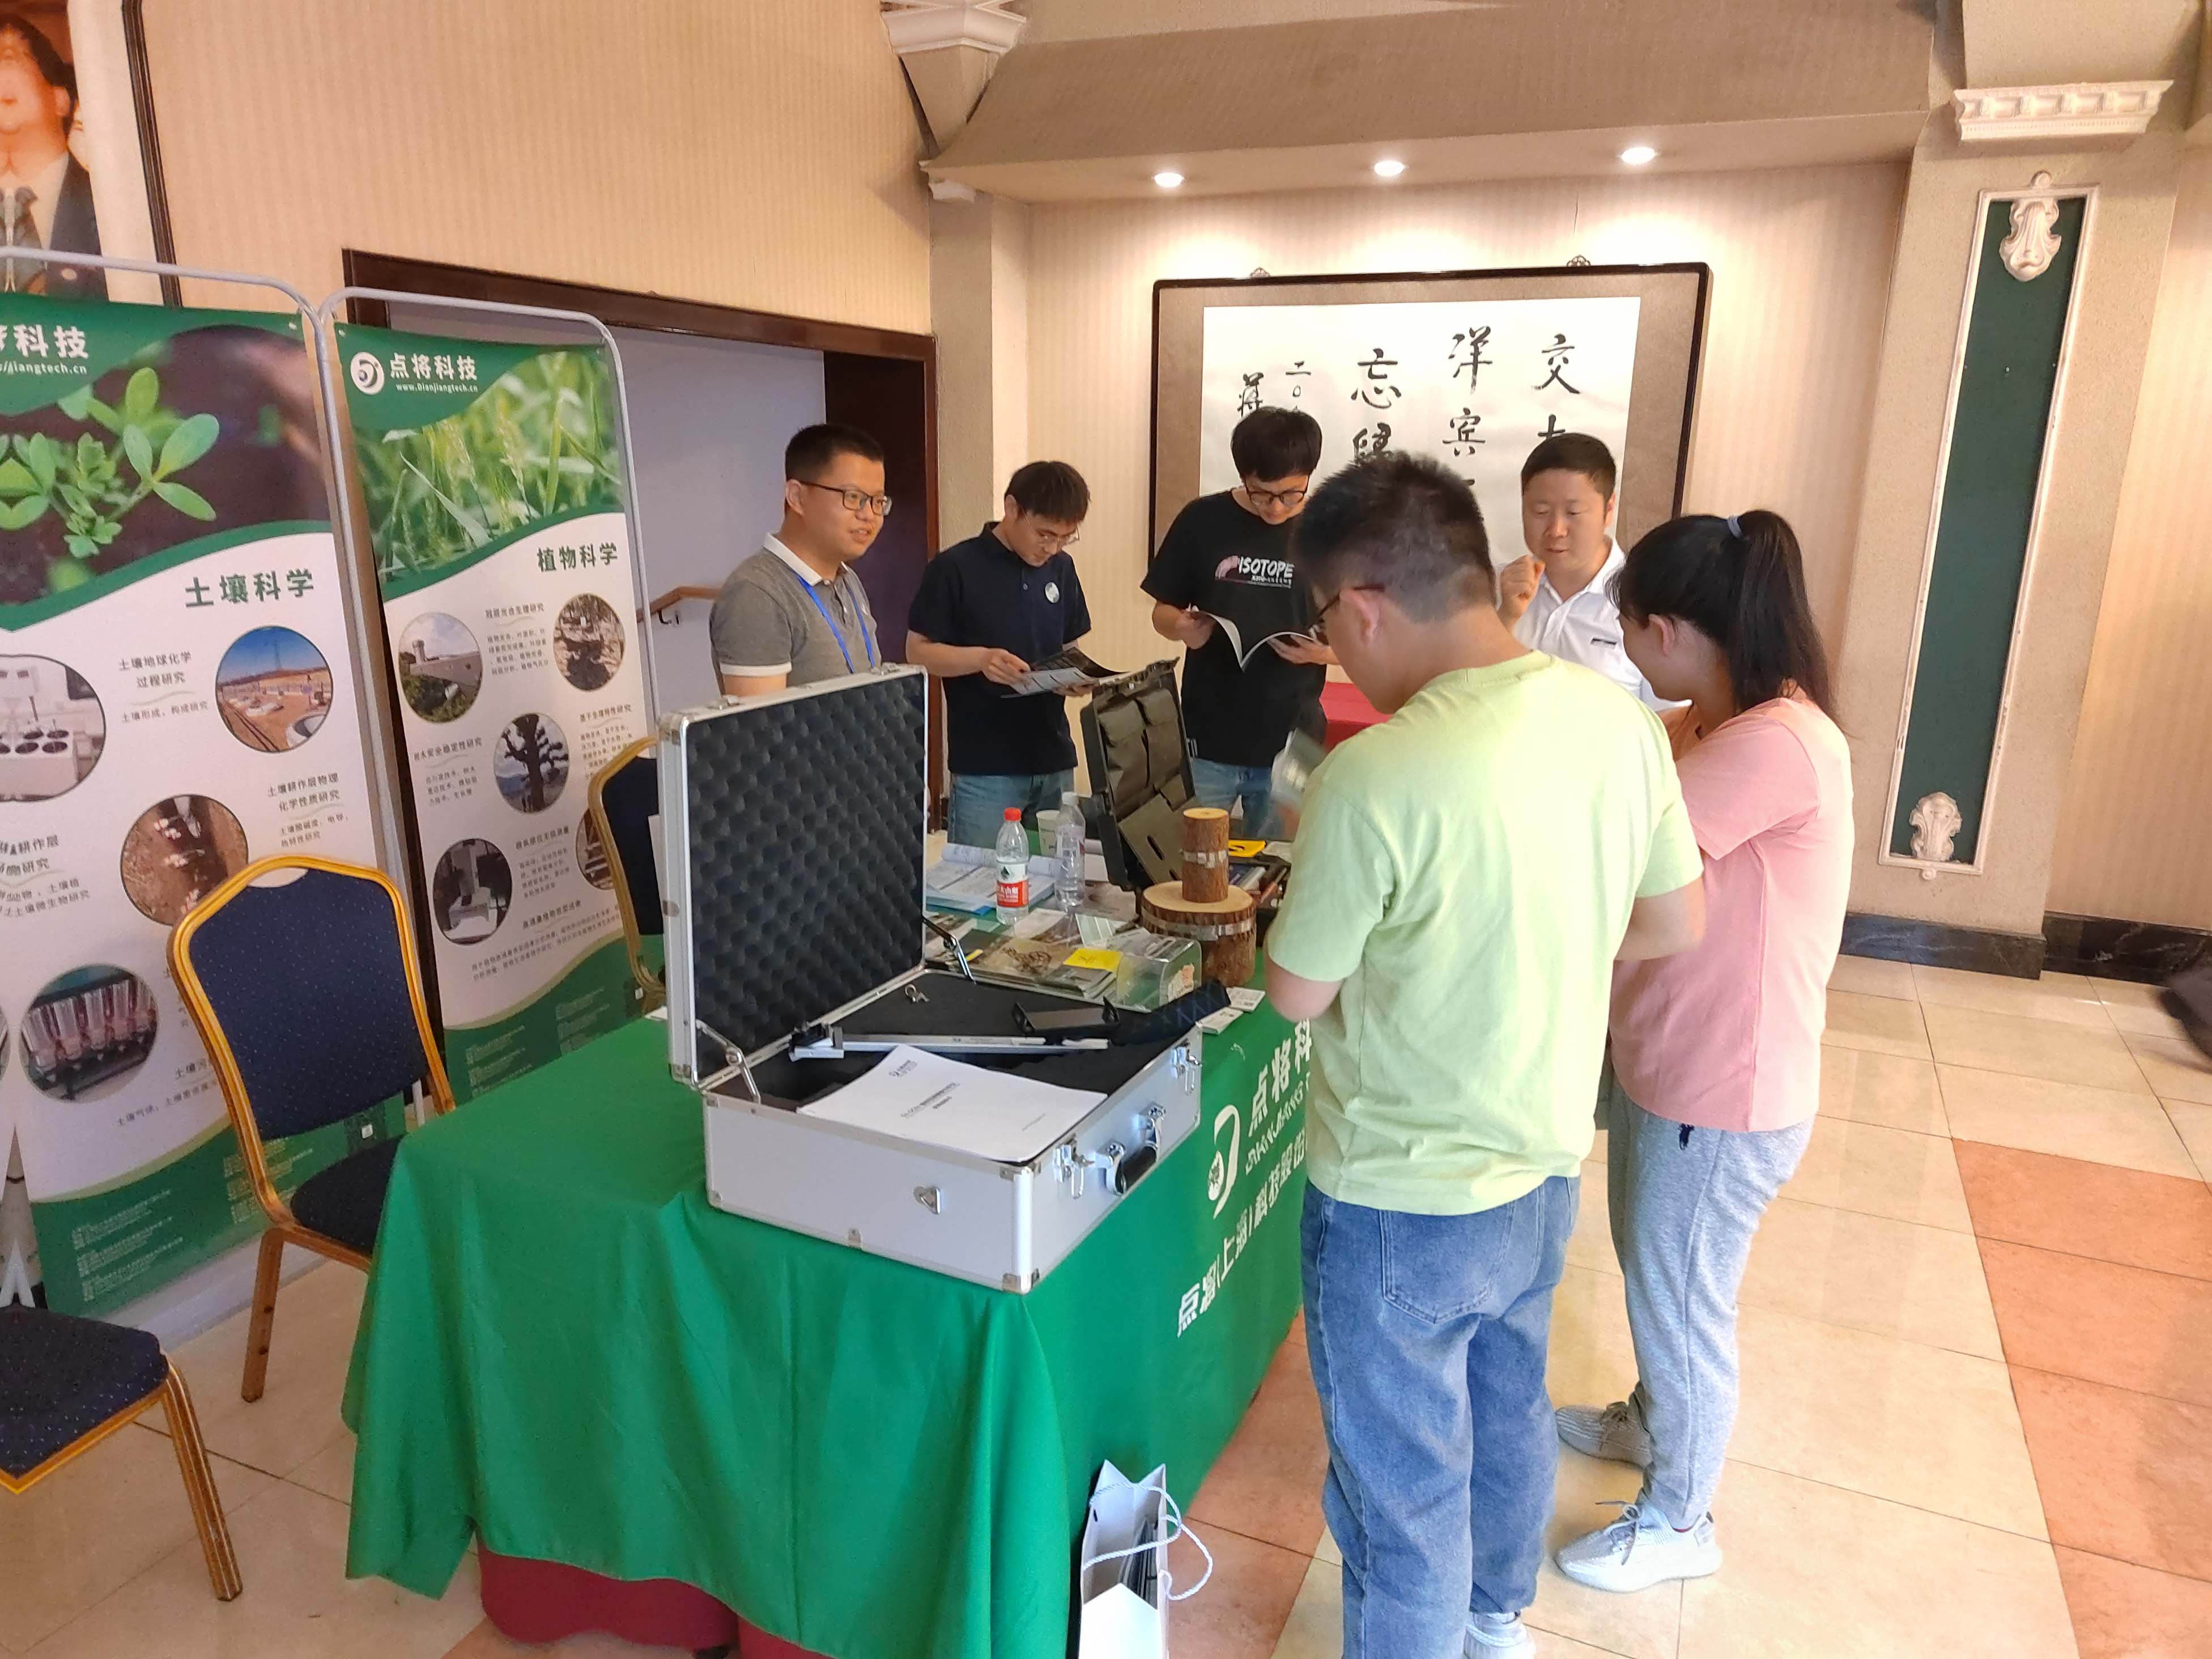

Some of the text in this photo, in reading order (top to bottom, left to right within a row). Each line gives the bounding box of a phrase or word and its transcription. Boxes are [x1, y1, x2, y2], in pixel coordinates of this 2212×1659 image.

[390, 352, 477, 380] 点将科技
[537, 542, 619, 572] 植物科学
[1239, 556, 1295, 578] ISOTOPE
[185, 568, 314, 608] 土壤科学
[118, 652, 192, 671] 土壤地球化学
[137, 671, 185, 689] 过程研究
